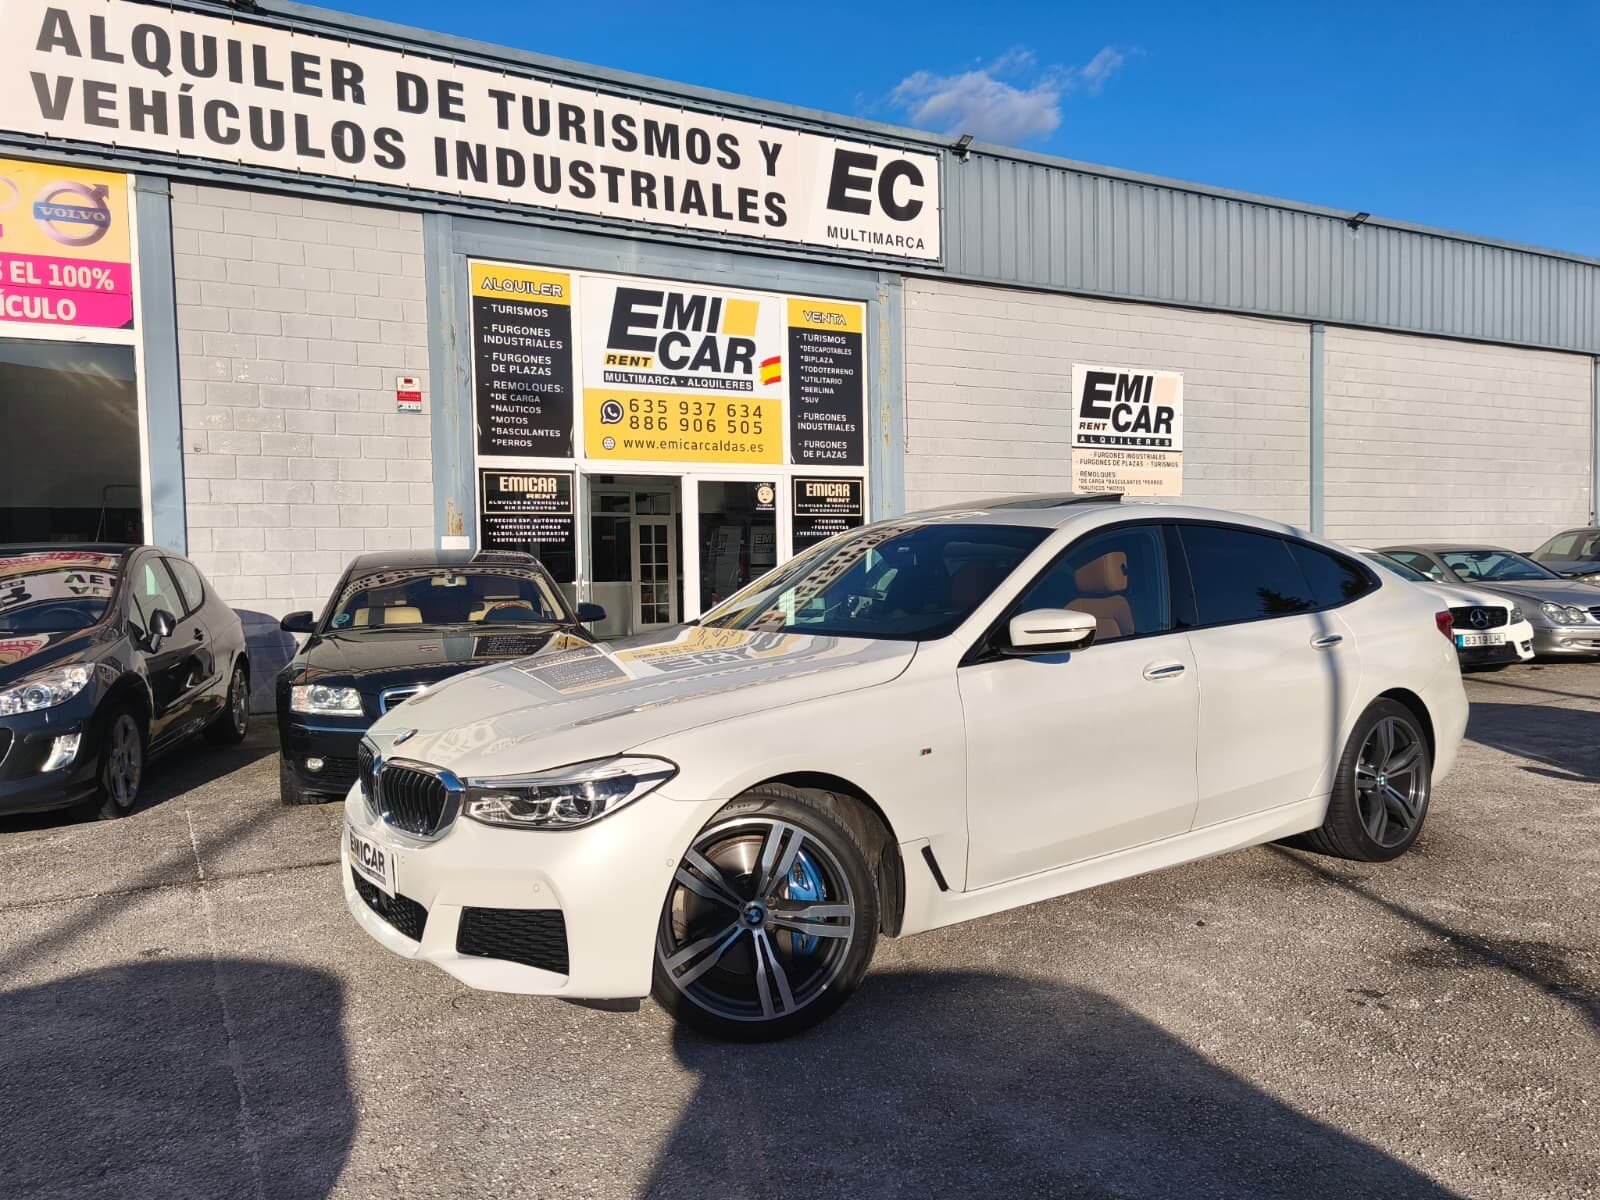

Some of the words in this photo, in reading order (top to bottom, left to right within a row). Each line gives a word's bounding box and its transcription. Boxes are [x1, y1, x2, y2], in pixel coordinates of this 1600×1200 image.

[36, 7, 366, 106] ALQUILER
[396, 70, 466, 122] DE
[488, 89, 741, 170] TURISMOS
[758, 140, 783, 177] Y
[30, 71, 407, 170] VEHÍCULOS
[434, 136, 788, 228] INDUSTRIALES
[826, 148, 924, 222] EC
[39, 206, 106, 222] VOLVO
[826, 225, 925, 250] MULTIMARCA
[10, 261, 41, 285] EL
[49, 264, 115, 291] 100%
[481, 277, 563, 298] ALQUILER
[491, 304, 549, 318] TURISMOS
[803, 310, 846, 326] VENTA
[606, 287, 722, 352] EMI
[491, 324, 551, 337] FURGONES
[483, 335, 563, 350] INDUSTRIALES
[803, 333, 846, 345] TURISMOS
[492, 352, 551, 365] FURGONES
[606, 354, 651, 367] RENT
[658, 331, 756, 375] CAR
[491, 364, 507, 374] DE
[509, 364, 552, 376] PLAZAS
[493, 381, 564, 393] REMOLQUES:
[605, 372, 677, 386] MULTIMARCA
[687, 377, 753, 391] ALQUILERES
[510, 393, 541, 403] CARGA
[1080, 371, 1154, 419] EMI
[629, 398, 668, 414] 635
[680, 401, 716, 417] 937
[727, 404, 763, 419] 634
[803, 413, 847, 422] FURGONES
[1112, 403, 1174, 434] CAR
[629, 416, 668, 431] 886
[680, 418, 716, 433] 906
[728, 420, 763, 435] 505
[797, 422, 856, 432] INDUSTRIALES
[1079, 422, 1107, 431] RENT
[623, 438, 764, 453] www.emicarcaldas.es
[803, 440, 847, 450] FURGONES
[1080, 436, 1170, 446] ALQUILERES
[803, 450, 814, 458] DE
[815, 450, 847, 459] PLAZAS
[1080, 458, 1111, 466] FURGONES
[1094, 451, 1125, 459] FURGONES
[500, 476, 557, 493] EMICAR
[805, 483, 850, 497] EMICAR
[349, 831, 386, 876] EMICAR
